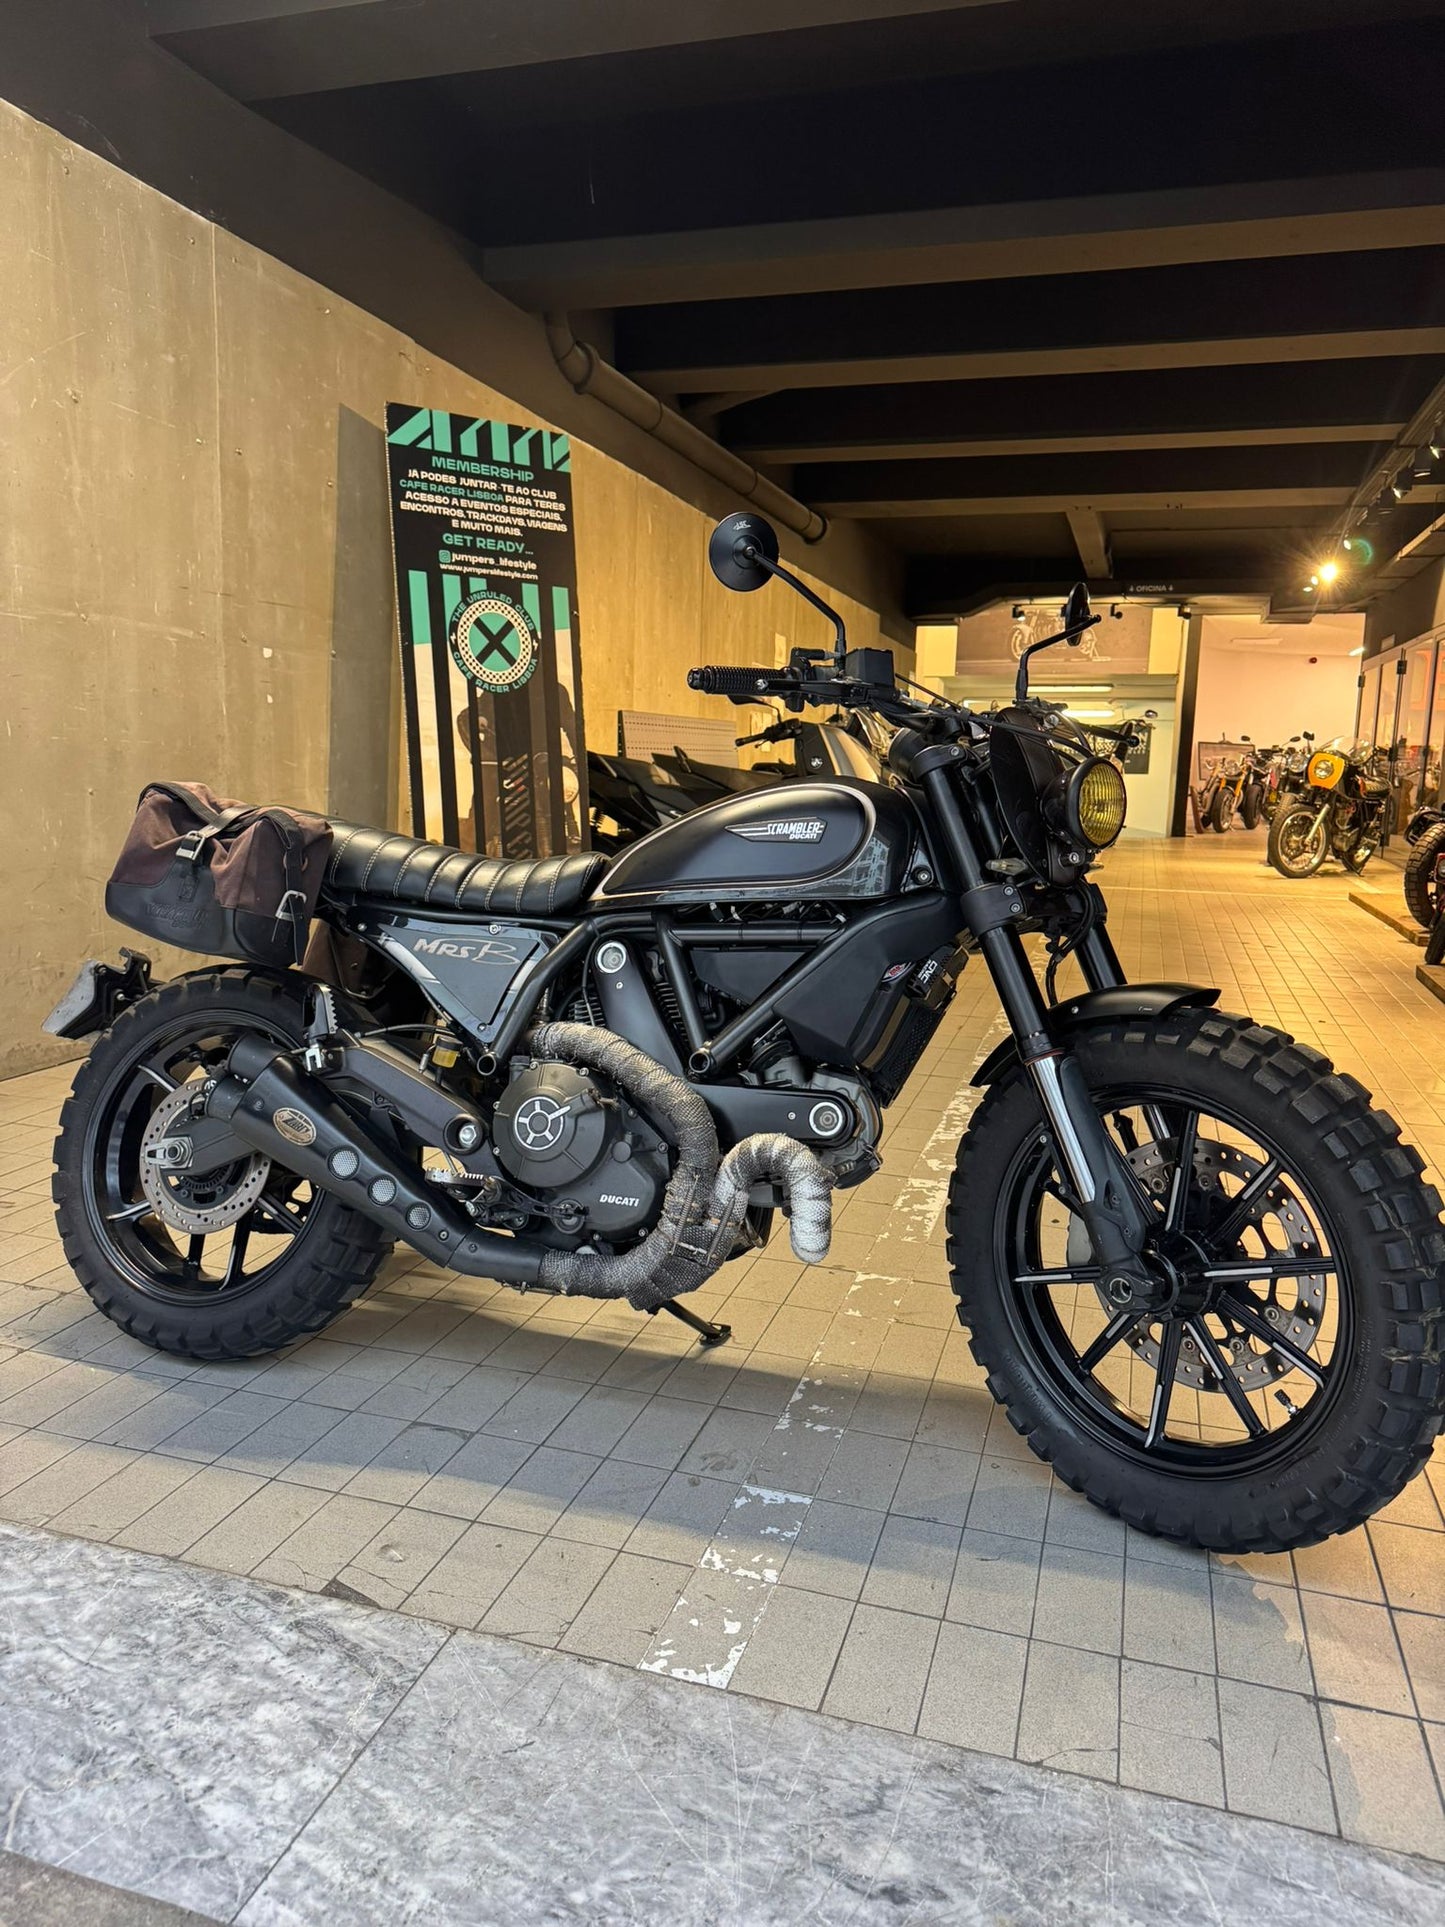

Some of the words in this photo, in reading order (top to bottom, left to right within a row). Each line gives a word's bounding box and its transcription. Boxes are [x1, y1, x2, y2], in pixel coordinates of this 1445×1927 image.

[432, 456, 534, 482] MEMBERSHIP
[399, 479, 429, 490] CAFE
[430, 483, 465, 497] RACER
[466, 489, 504, 502] LISBOA
[505, 495, 533, 506] PARA
[533, 499, 566, 512] TERES
[420, 471, 457, 484] PODES
[515, 486, 530, 496] AO
[531, 488, 557, 500] CLUB
[405, 491, 450, 504] ACESSO
[451, 497, 460, 506] A
[460, 498, 509, 513] EVENTOS
[452, 519, 460, 528] E
[460, 520, 493, 533] MUITO
[494, 525, 523, 537] MAIS.
[526, 519, 568, 532] VIAGENS
[442, 533, 474, 547] GET
[452, 602, 467, 623] THE
[466, 591, 512, 604] UNRULED
[515, 604, 534, 630] CLUB
[453, 652, 474, 680] CAFE
[475, 679, 510, 693] RACER
[512, 658, 537, 689] LISBOA
[767, 822, 822, 835] SCRAMBLER
[921, 960, 938, 984] CNC
[599, 1194, 640, 1207] DUCATI
